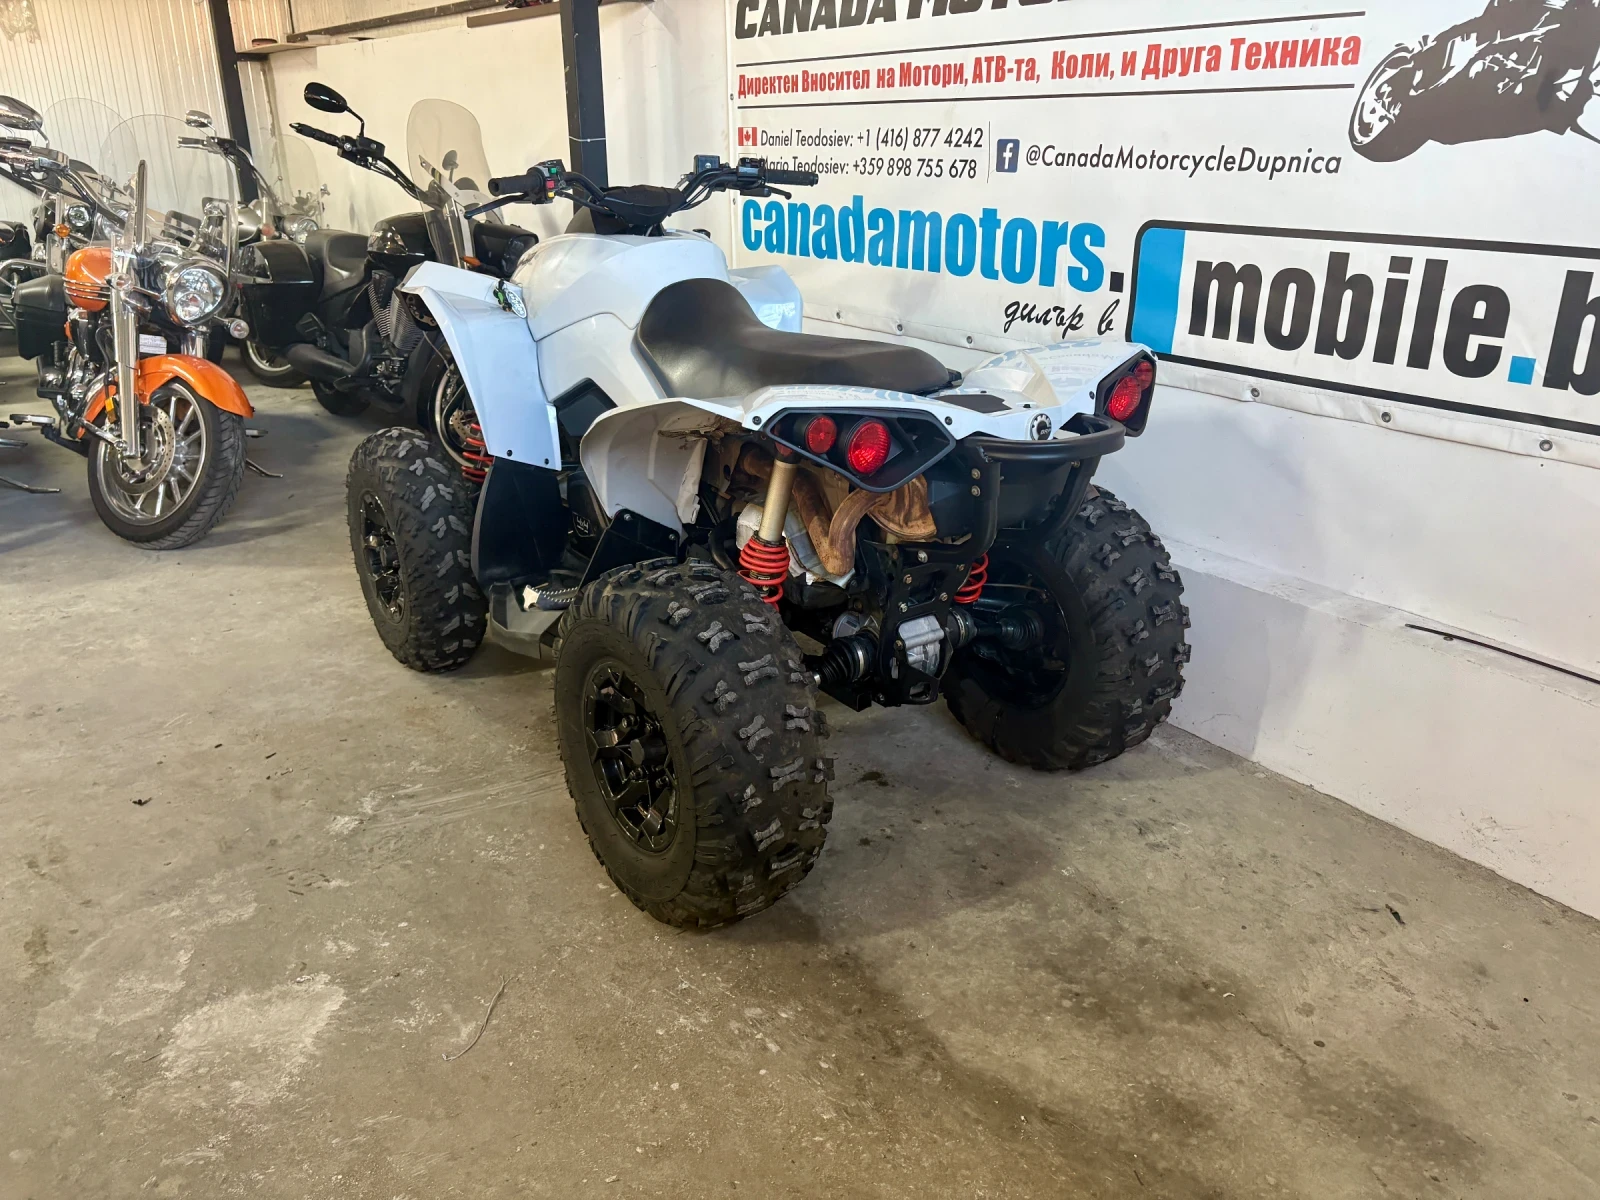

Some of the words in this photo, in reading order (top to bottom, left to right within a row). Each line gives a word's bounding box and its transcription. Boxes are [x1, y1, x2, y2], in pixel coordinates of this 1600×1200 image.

[735, 0, 897, 39] CANADA
[737, 73, 799, 98] Директен
[801, 68, 871, 92] Вносител
[876, 67, 896, 89] на
[898, 61, 969, 89] Мотори,
[971, 55, 1041, 85] АТВ-та,
[1051, 50, 1115, 80] Коли,
[1120, 50, 1137, 77] и
[1141, 43, 1222, 81] Друга
[1229, 35, 1362, 71] Техника
[760, 128, 793, 147] Daniel
[795, 127, 854, 147] Teodosiev:
[857, 129, 870, 147] +1
[876, 126, 909, 151] (416)
[912, 128, 941, 148] 877
[943, 127, 984, 148] 4242
[792, 155, 850, 175] Teodosiev:
[852, 156, 884, 176] +359
[886, 157, 912, 177] 898
[916, 158, 944, 178] 755
[948, 159, 977, 179] 678
[1025, 143, 1342, 181] @CanadaMotorcycleDupnica
